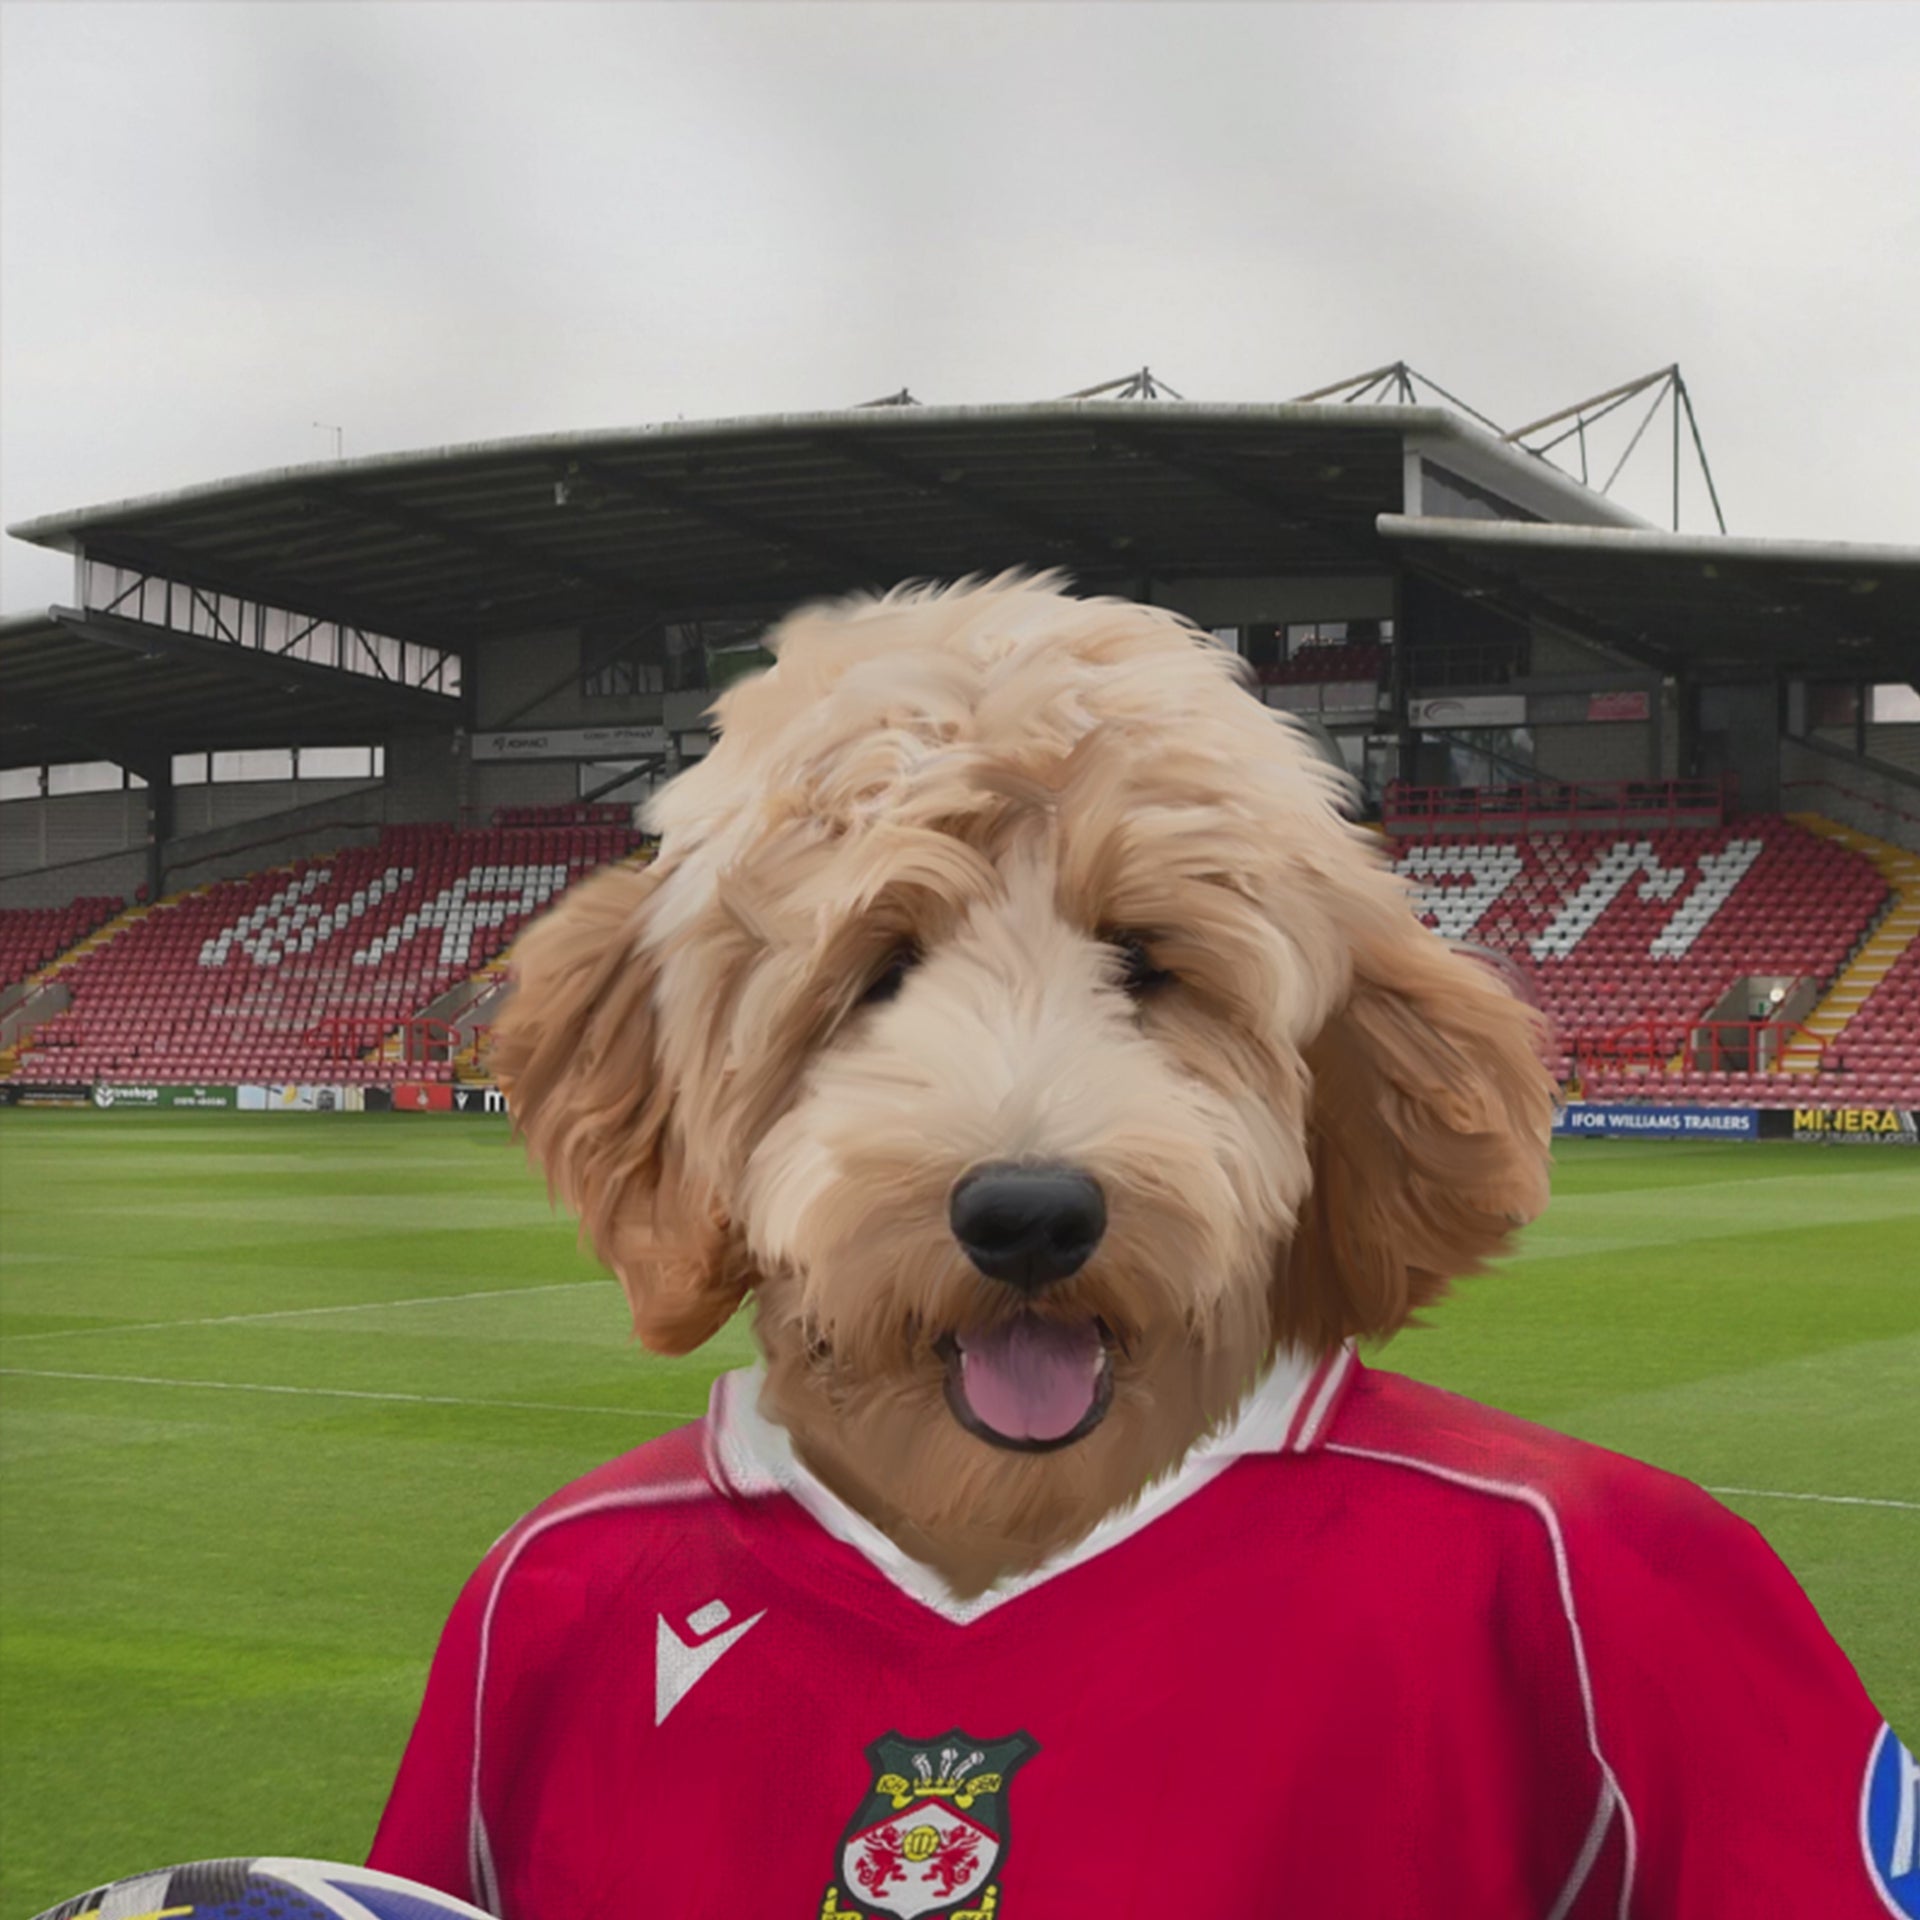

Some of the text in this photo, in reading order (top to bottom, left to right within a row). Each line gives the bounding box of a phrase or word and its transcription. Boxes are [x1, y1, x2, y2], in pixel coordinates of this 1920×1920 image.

[1572, 1113, 1750, 1130] IFOR WILLIAMS TRAILERS
